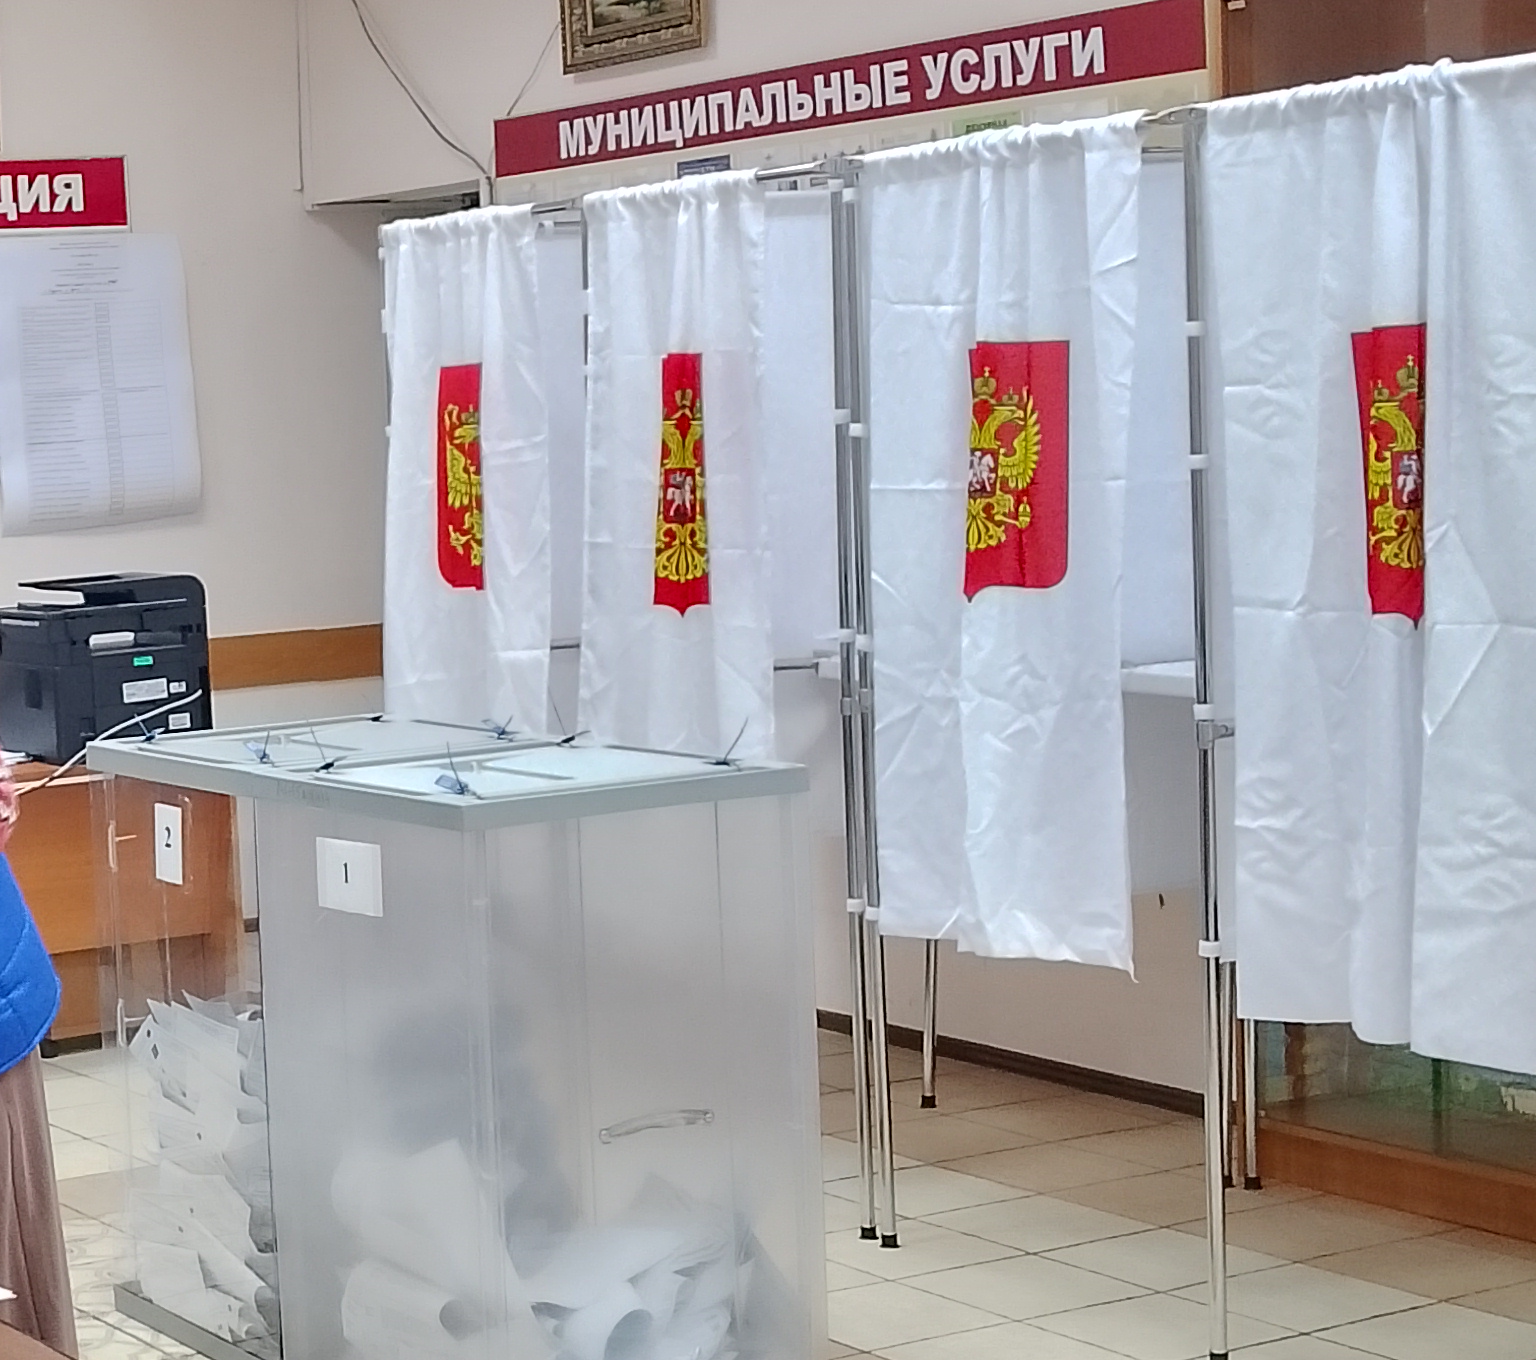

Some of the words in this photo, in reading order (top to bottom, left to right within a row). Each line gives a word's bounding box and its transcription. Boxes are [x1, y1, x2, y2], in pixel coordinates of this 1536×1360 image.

[558, 59, 911, 160] МУНИЦИПАЛЬНЫЕ
[920, 26, 1106, 101] УСЛУГИ
[164, 826, 172, 848] 2
[342, 861, 349, 884] 1
